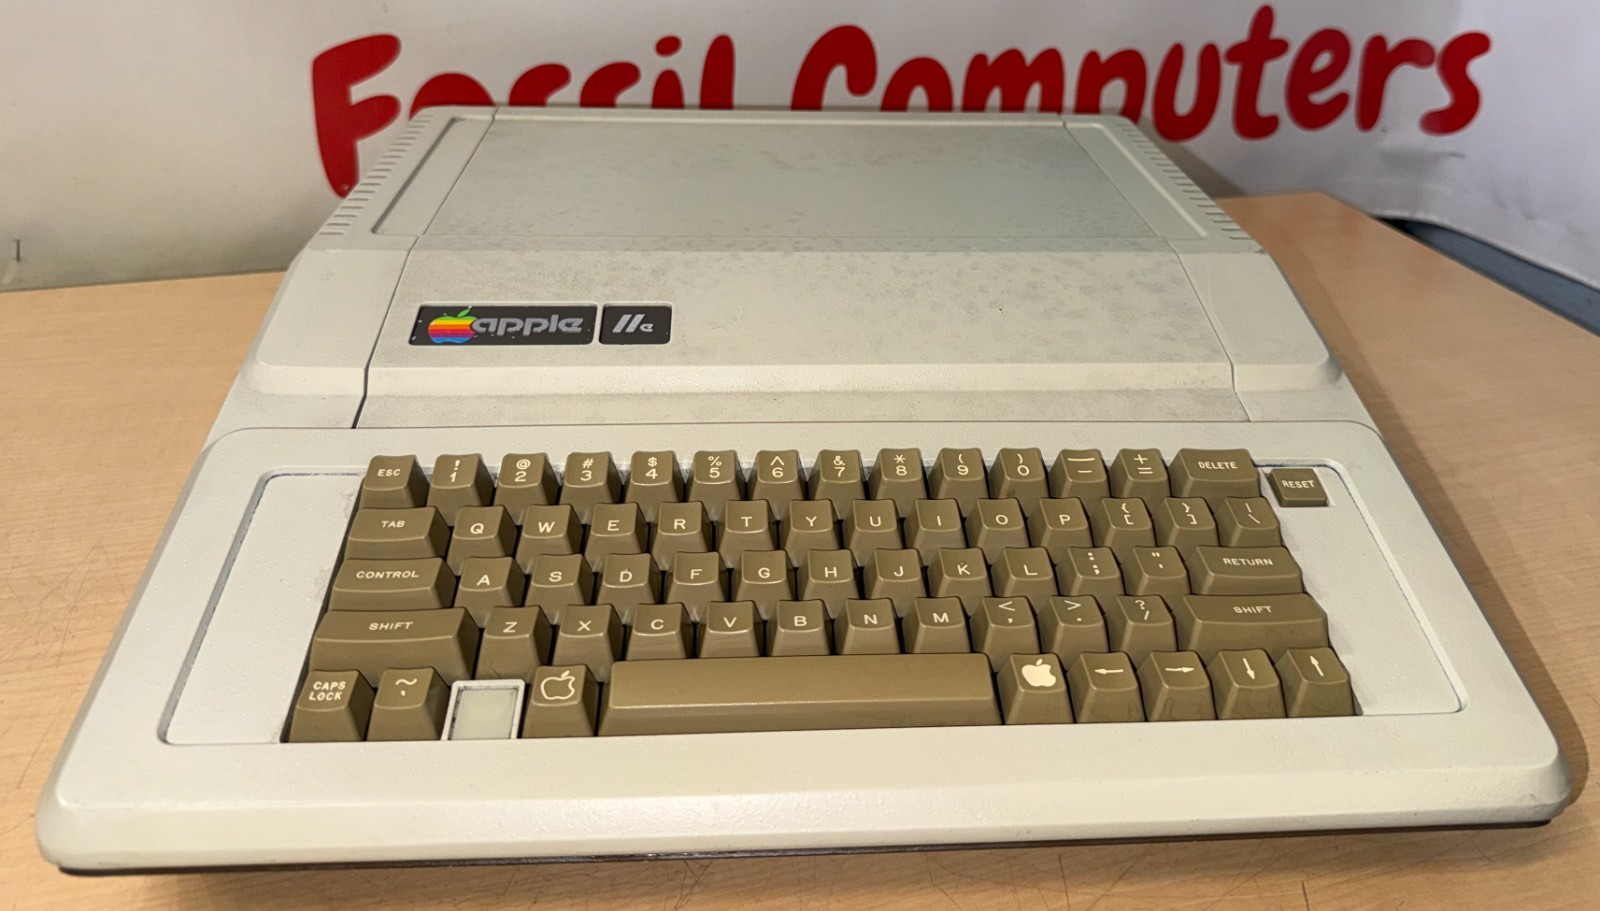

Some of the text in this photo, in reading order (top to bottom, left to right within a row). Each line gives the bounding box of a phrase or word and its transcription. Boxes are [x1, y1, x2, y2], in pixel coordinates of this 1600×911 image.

[470, 314, 584, 337] apple
[453, 459, 461, 471] !
[516, 458, 532, 470] @
[581, 457, 594, 469] #
[647, 456, 658, 468] $
[707, 455, 723, 467] %
[833, 455, 846, 466] &
[1133, 453, 1148, 465] +
[895, 465, 908, 476] 8
[956, 464, 969, 476] 9
[1137, 466, 1154, 475] =
[1197, 461, 1238, 470] DELETE
[377, 468, 401, 477] ESC
[450, 468, 458, 483] 1
[514, 470, 527, 483] 2
[580, 469, 593, 482] 3
[645, 468, 659, 480] 4
[708, 467, 721, 479] 5
[771, 466, 784, 478] 6
[834, 466, 846, 478] 7
[1281, 479, 1315, 489] RESET
[381, 520, 406, 528] TAB
[673, 518, 687, 530] R
[740, 516, 753, 528] T
[805, 515, 818, 527] Y
[869, 516, 882, 527] U
[995, 514, 1009, 525] O
[1059, 514, 1071, 526] P
[1123, 514, 1134, 525] [
[1186, 513, 1198, 525] ]
[470, 522, 485, 535] Q
[538, 521, 556, 534] W
[607, 519, 620, 532] E
[1222, 557, 1274, 566] RETURN
[355, 570, 419, 579] CONTROL
[690, 568, 703, 580] F
[757, 567, 771, 579] G
[824, 566, 838, 578] H
[893, 565, 904, 577] J
[957, 563, 971, 575] K
[1023, 564, 1038, 576] L
[476, 574, 491, 586] A
[548, 571, 563, 583] S
[619, 571, 633, 583] D
[998, 600, 1016, 612] <
[1064, 600, 1082, 611] >
[1134, 599, 1146, 610] ?
[1233, 605, 1272, 614] SHIFT
[723, 616, 737, 628] V
[793, 615, 808, 627] B
[863, 614, 878, 625] N
[932, 612, 950, 623] M
[368, 621, 414, 631] SHIFT
[502, 621, 518, 633] Z
[577, 620, 592, 632] X
[650, 618, 664, 631] C
[313, 680, 347, 691] CAPS
[308, 691, 343, 701] LOCK
